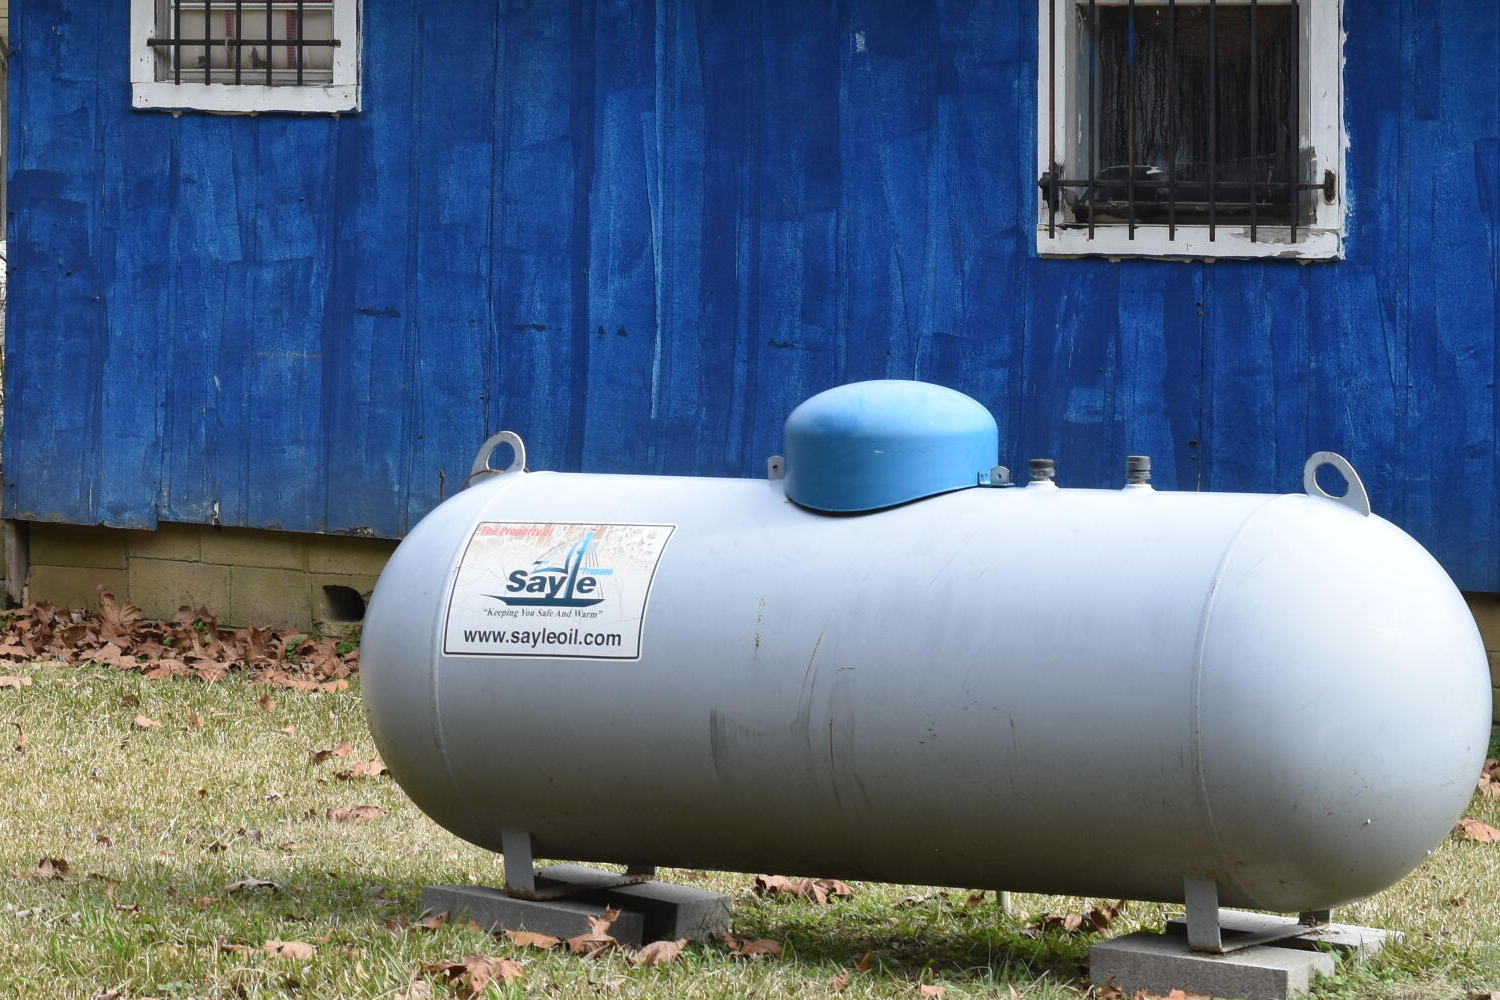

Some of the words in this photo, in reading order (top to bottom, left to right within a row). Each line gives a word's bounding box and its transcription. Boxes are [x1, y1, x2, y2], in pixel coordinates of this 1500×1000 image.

[506, 564, 597, 600] Sayle
[521, 608, 535, 617] You
[537, 608, 553, 617] Safe
[555, 609, 572, 618] And
[463, 628, 622, 648] www.sayleoil.com
